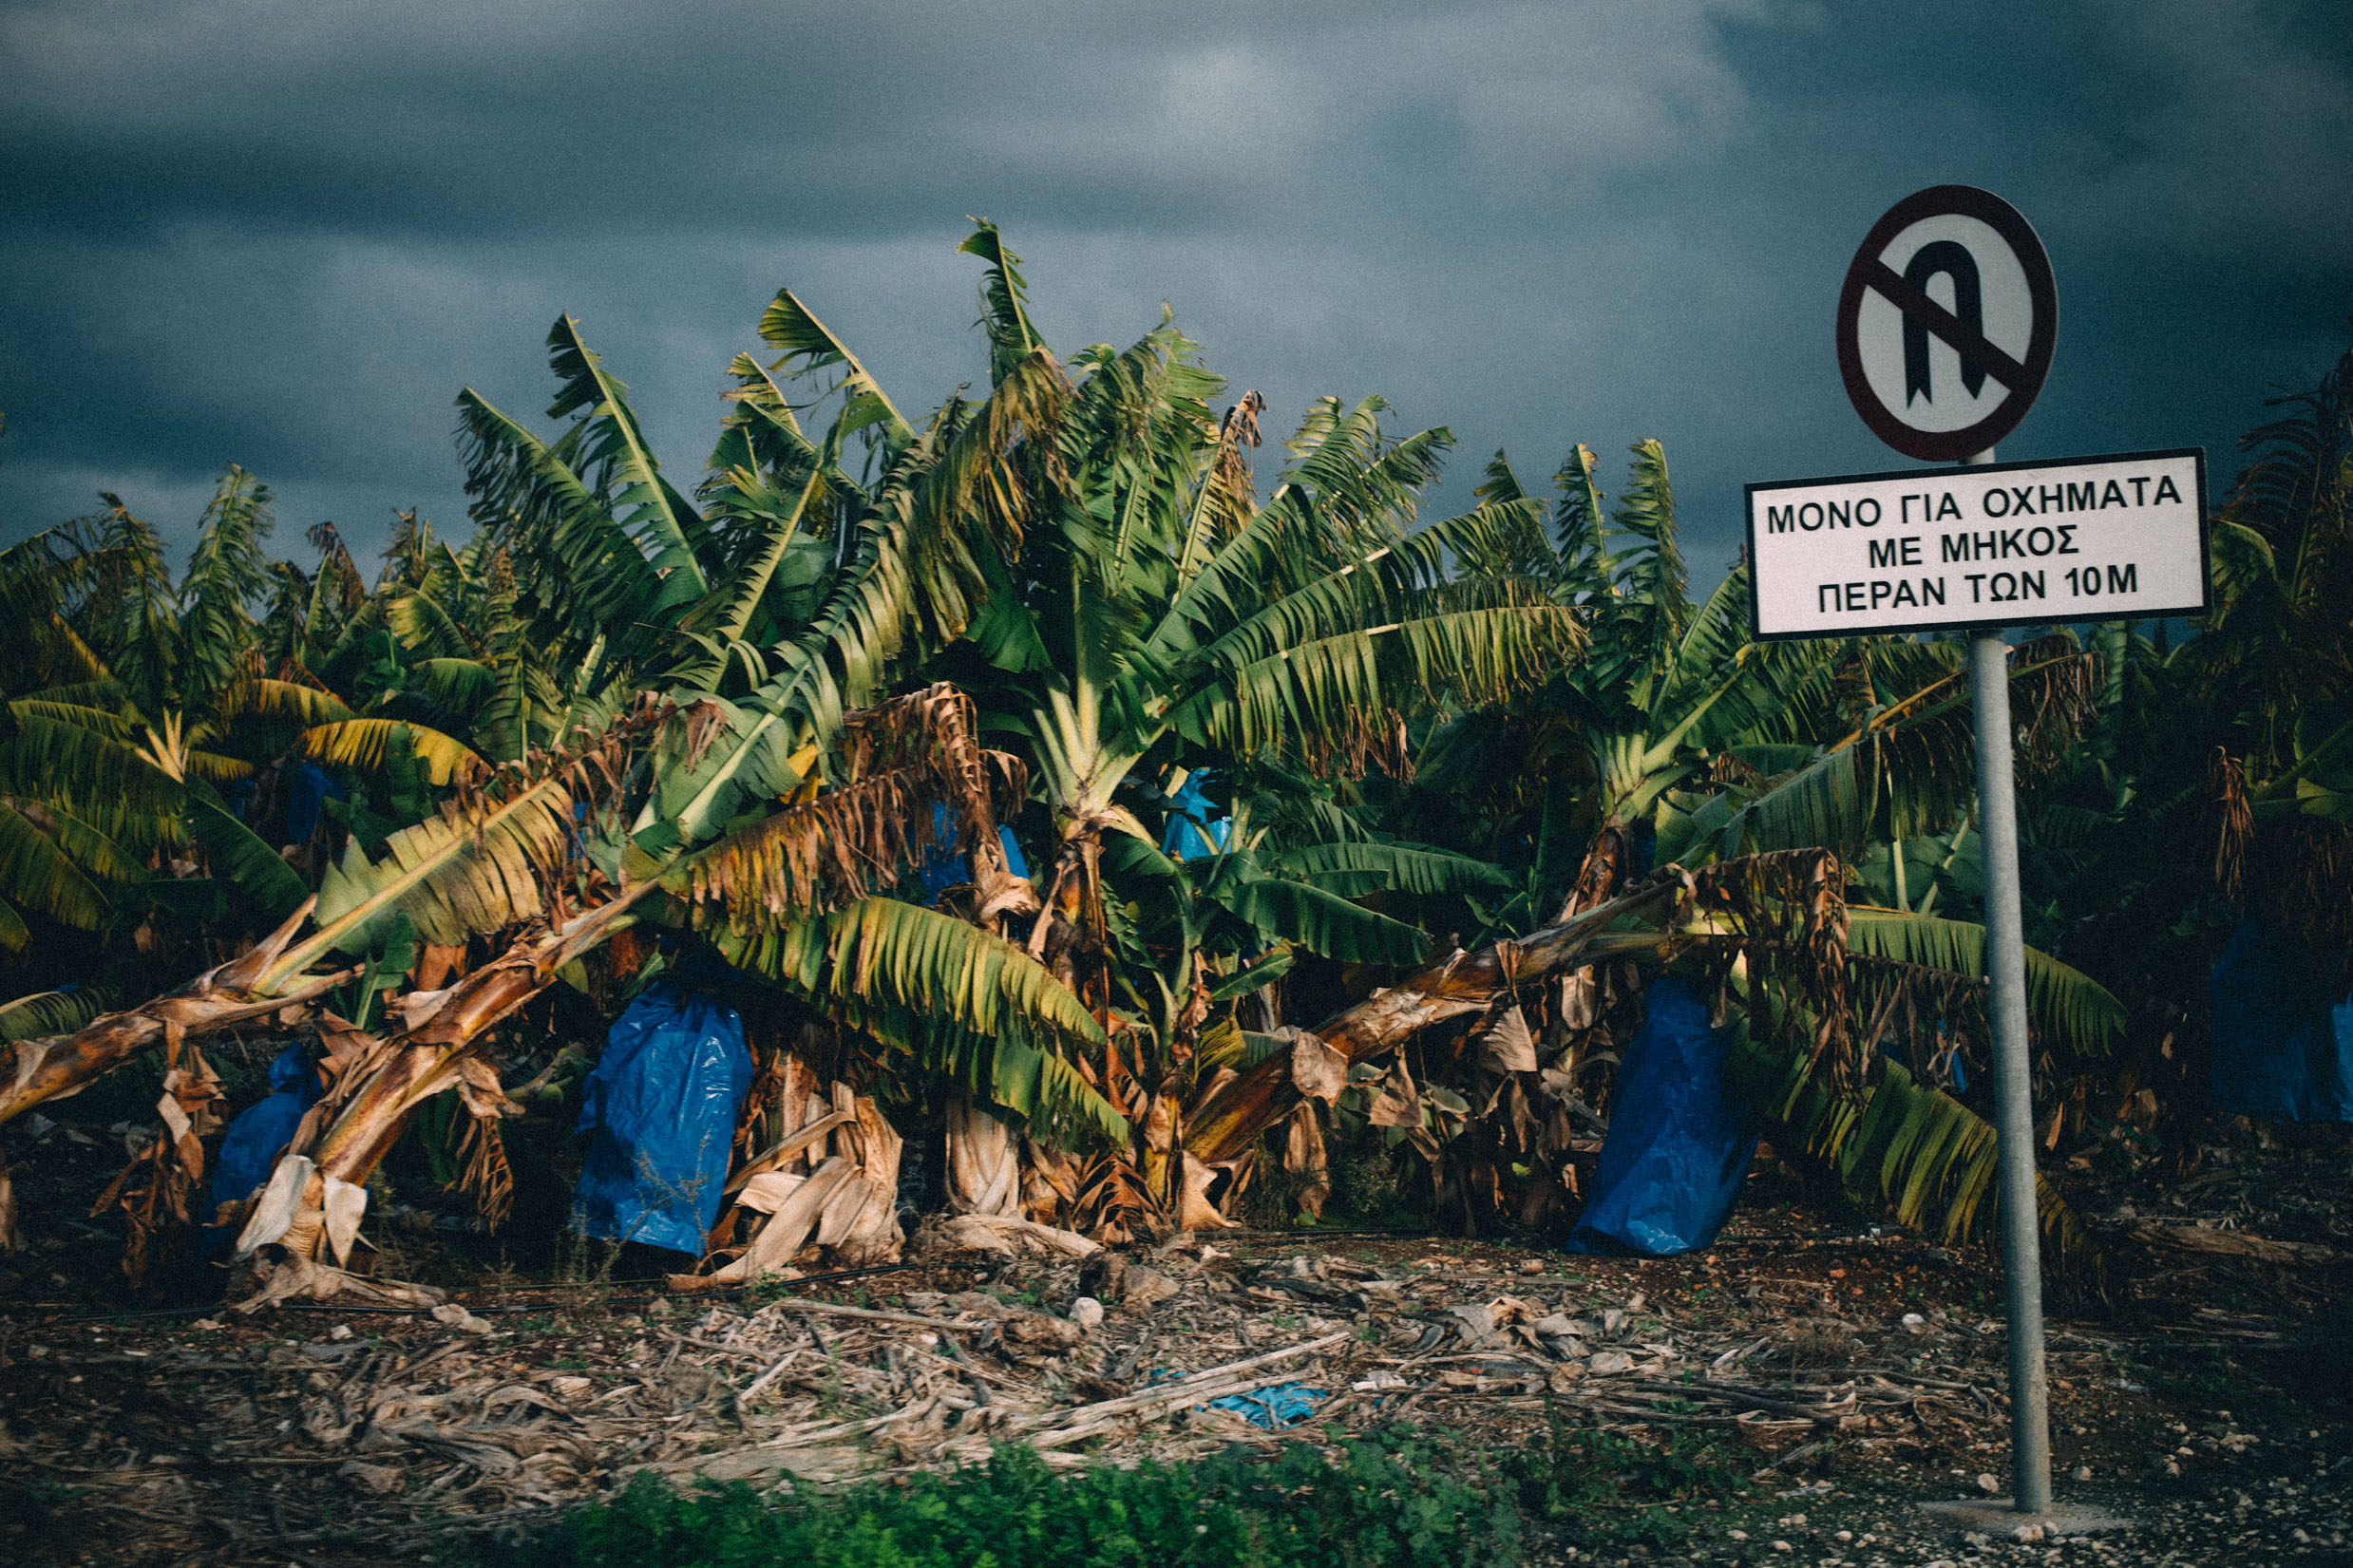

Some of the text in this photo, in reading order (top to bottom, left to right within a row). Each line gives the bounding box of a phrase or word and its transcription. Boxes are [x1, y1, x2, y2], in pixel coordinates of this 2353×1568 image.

[1768, 475, 2183, 535] ΜΟΝΟ ΓΙΑ ΟΧΗΜΑΤΑ
[1869, 523, 2079, 569] ΜΕ ΜΗΚΟΣ
[1818, 576, 1945, 614] ΠΕΡΑΝ
[1964, 570, 2046, 603] ΤΩΝ
